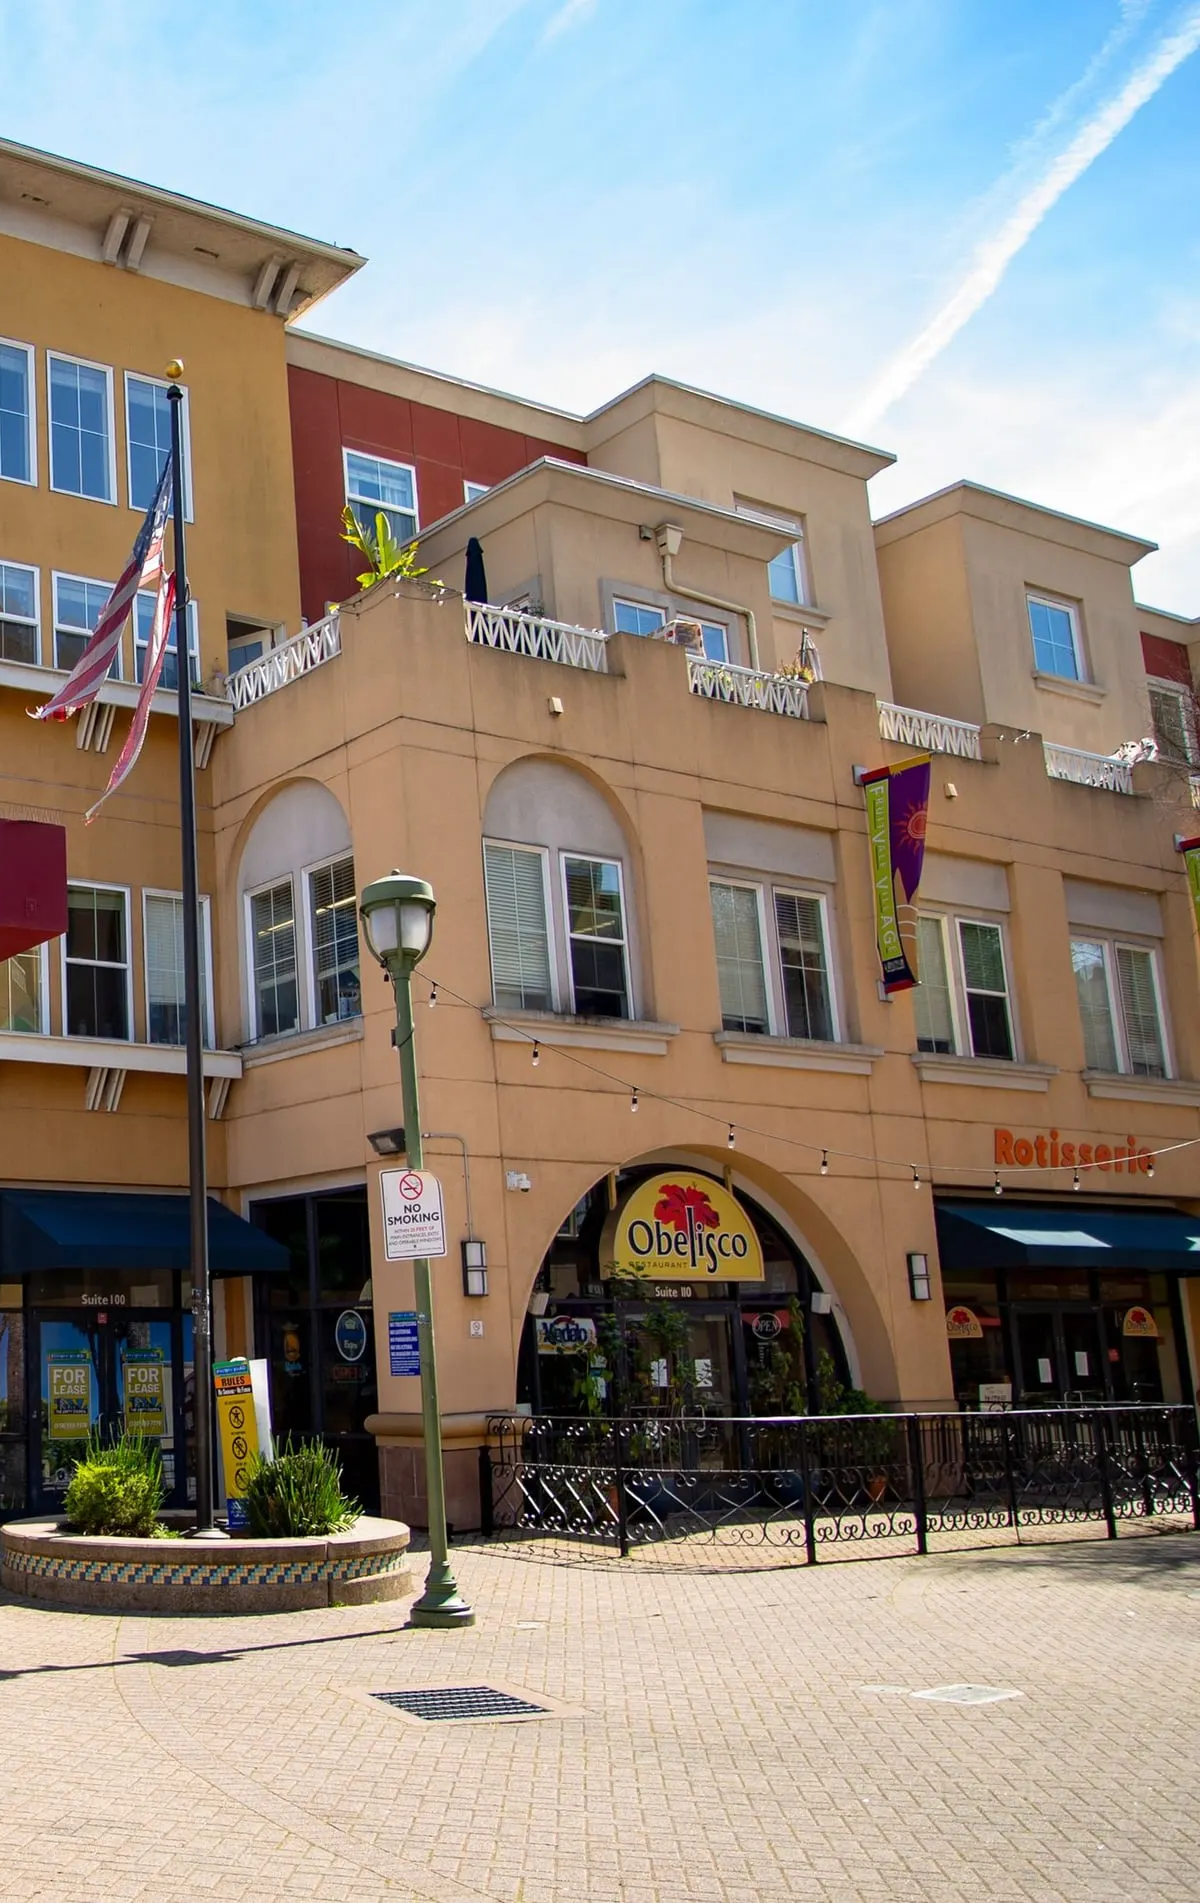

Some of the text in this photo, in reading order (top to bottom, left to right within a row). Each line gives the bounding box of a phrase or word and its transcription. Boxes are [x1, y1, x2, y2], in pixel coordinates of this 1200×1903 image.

[869, 785, 888, 871] FRUITVALE
[876, 875, 898, 955] VILLAGE
[994, 1127, 1156, 1175] Rotisserie
[404, 1203, 421, 1214] NO
[387, 1211, 440, 1226] SMOKING
[627, 1205, 748, 1275] Obelisco
[81, 1294, 126, 1305] Suite 100
[655, 1286, 692, 1298] Suite 110
[53, 1368, 86, 1384] FOR
[127, 1367, 159, 1383] FOR
[221, 1375, 245, 1387] RULES
[53, 1384, 87, 1395] LEASE
[128, 1383, 160, 1393] LEASE
